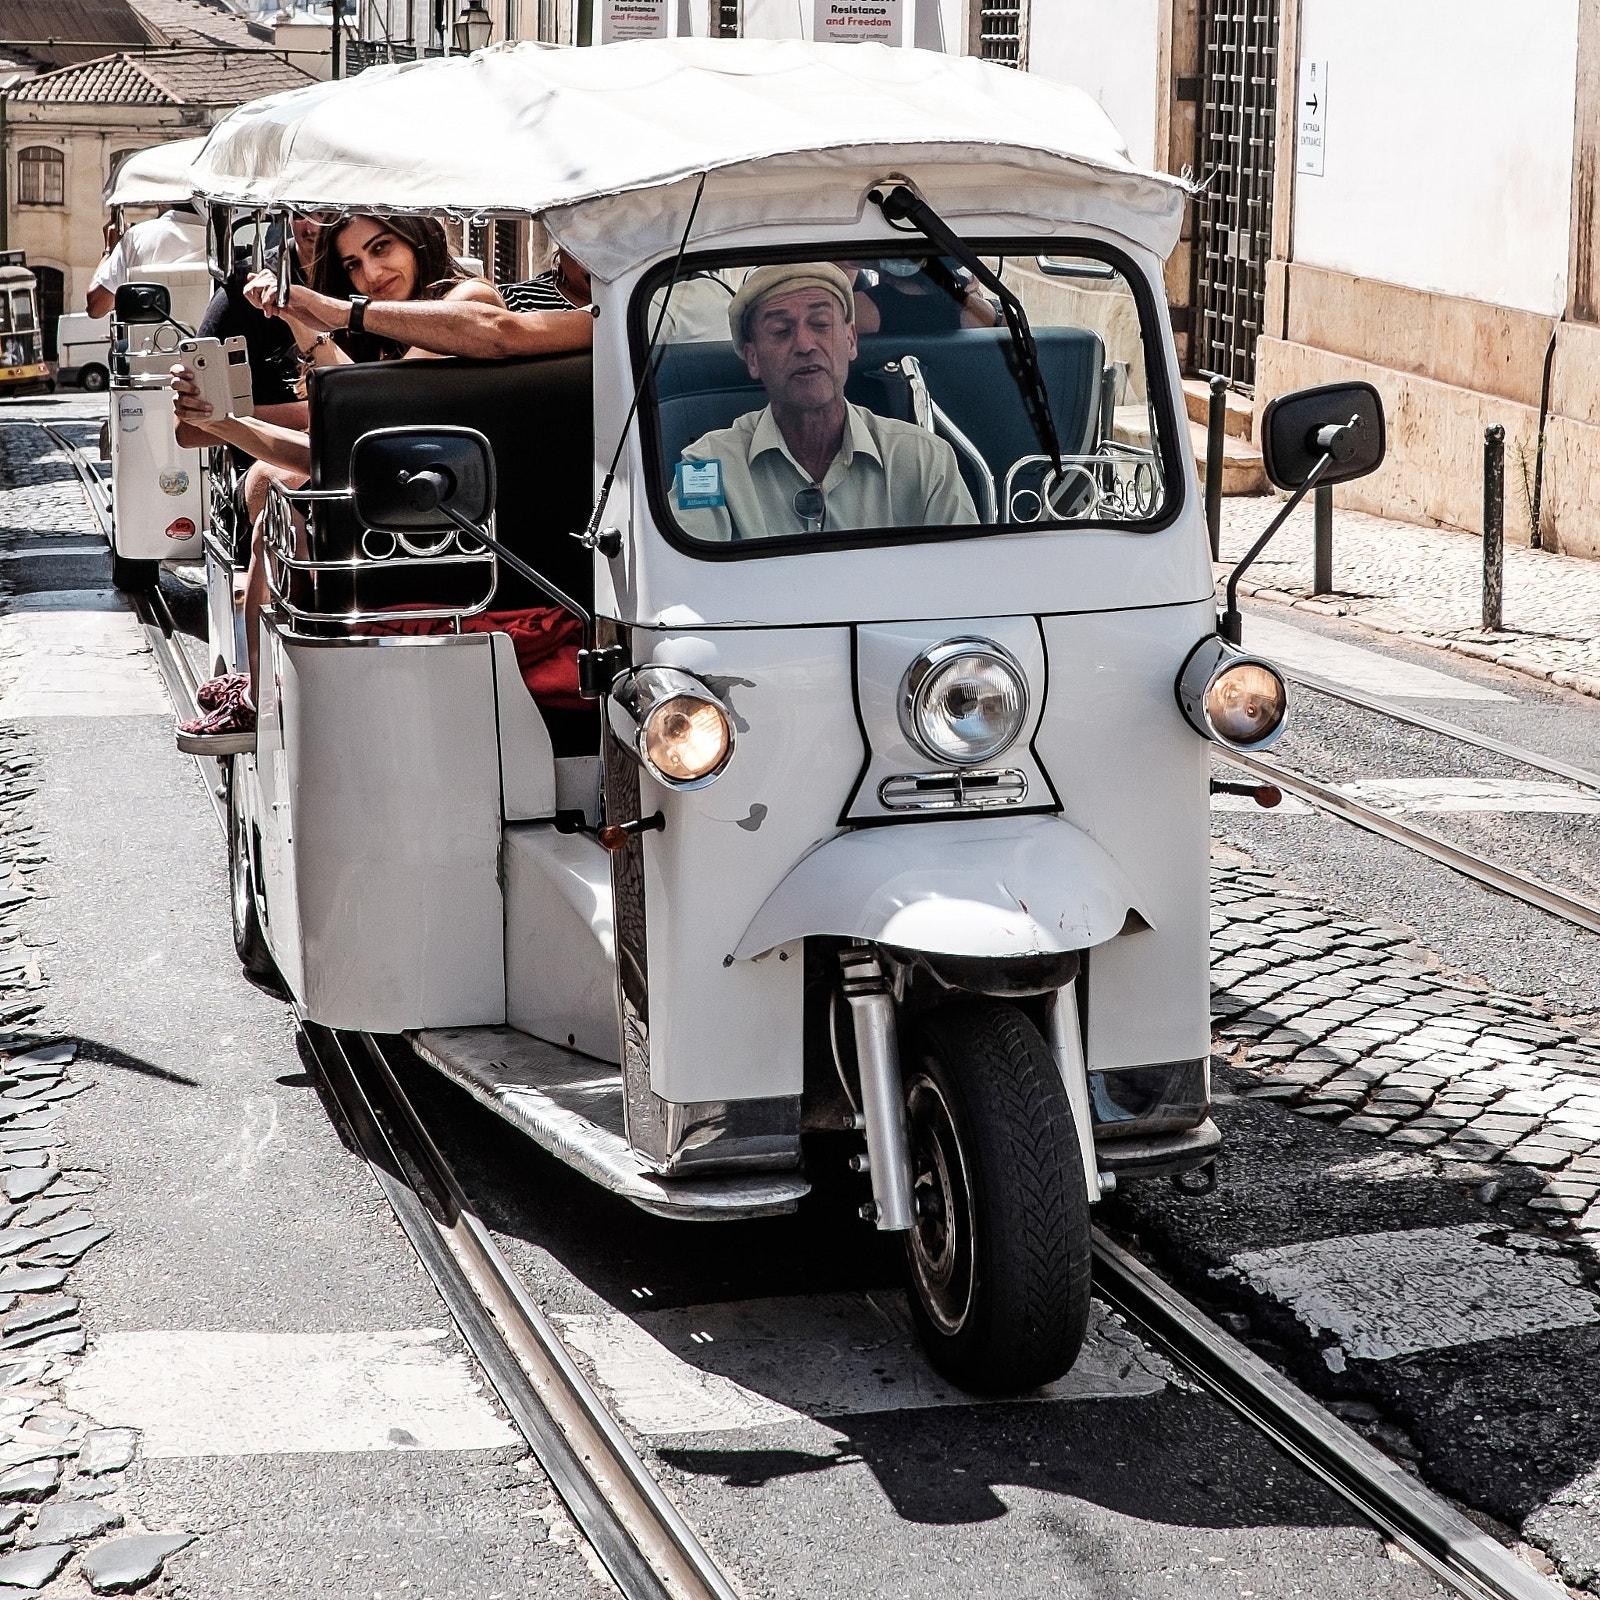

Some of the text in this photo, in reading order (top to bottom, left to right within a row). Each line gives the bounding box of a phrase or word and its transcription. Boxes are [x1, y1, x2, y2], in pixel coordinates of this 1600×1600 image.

[831, 4, 887, 14] Resistance
[826, 16, 891, 26] and Freedom
